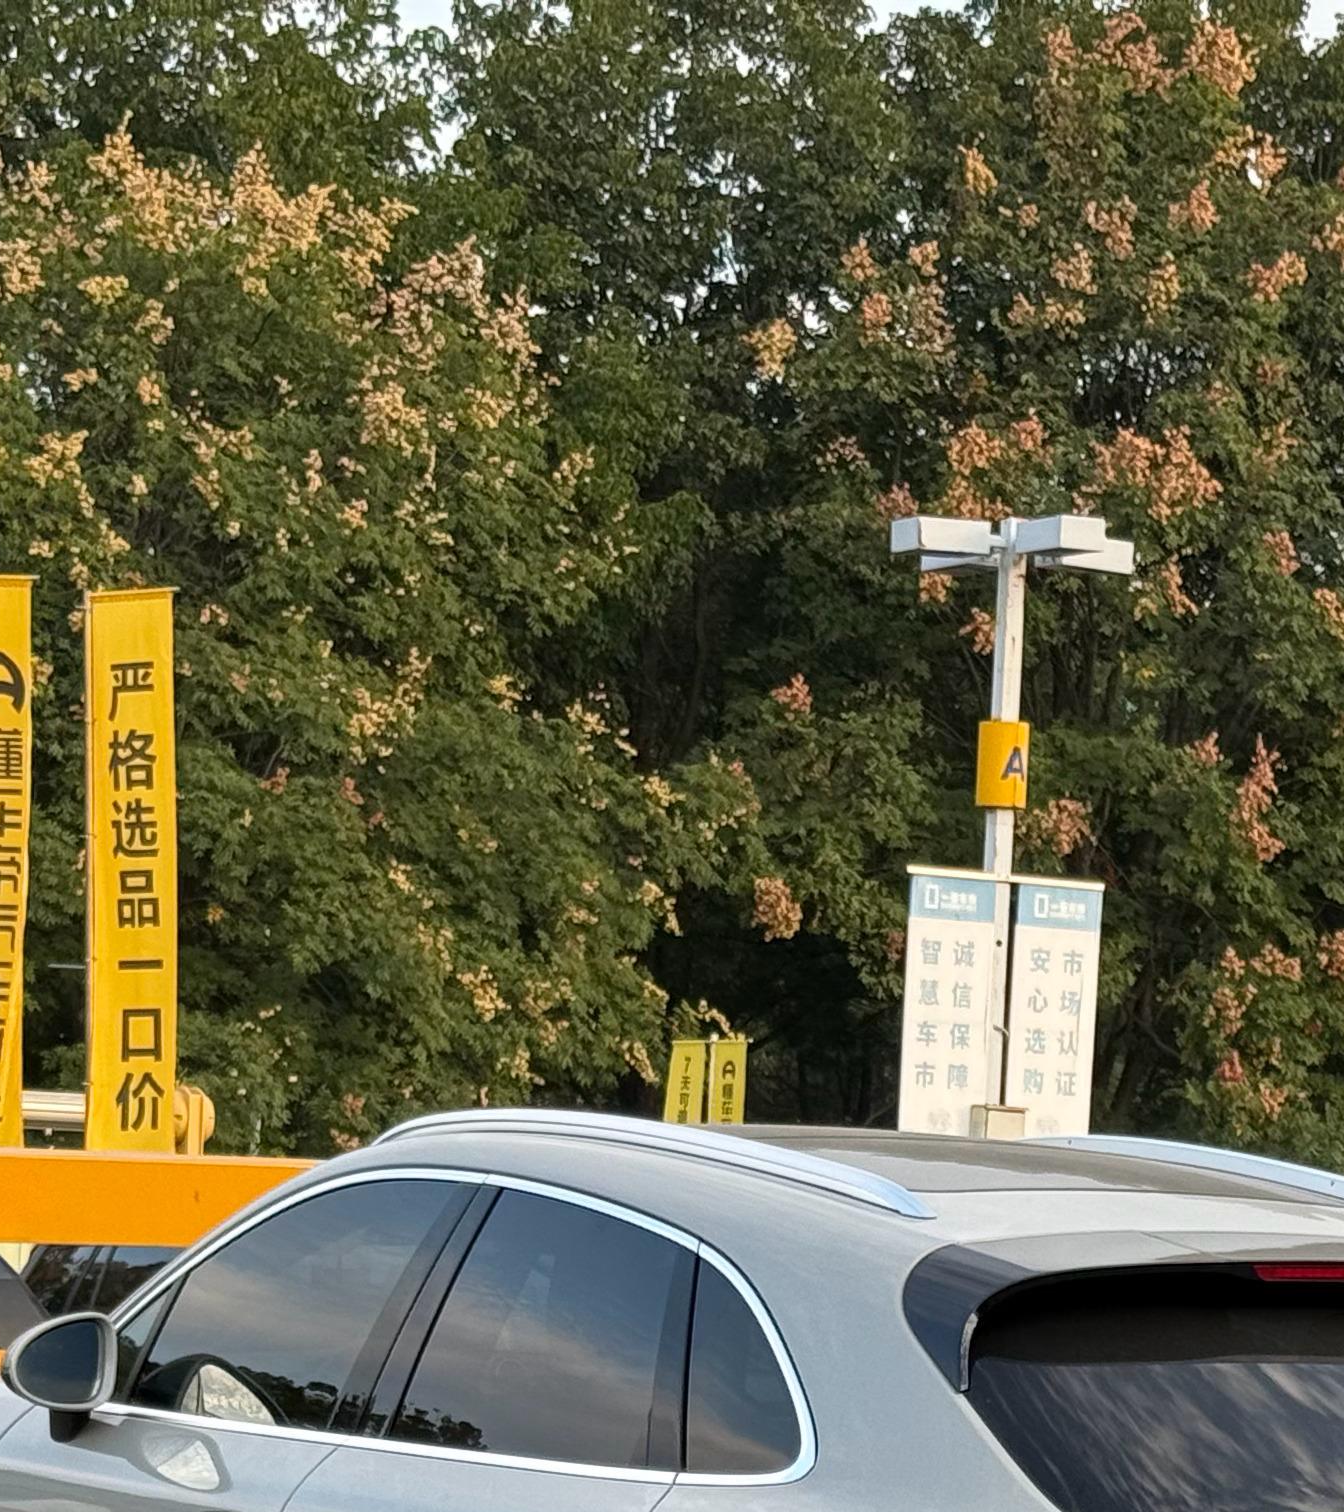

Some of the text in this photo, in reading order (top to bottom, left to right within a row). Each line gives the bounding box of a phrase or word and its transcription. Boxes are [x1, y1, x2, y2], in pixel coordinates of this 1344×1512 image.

[1000, 746, 1025, 782] A
[107, 660, 166, 1133] 严格选品一口价
[914, 937, 942, 1090] 智慧车市
[947, 940, 975, 1091] 诚信保障
[1023, 948, 1051, 1096] 安心选购
[1055, 950, 1084, 1098] 市场认证
